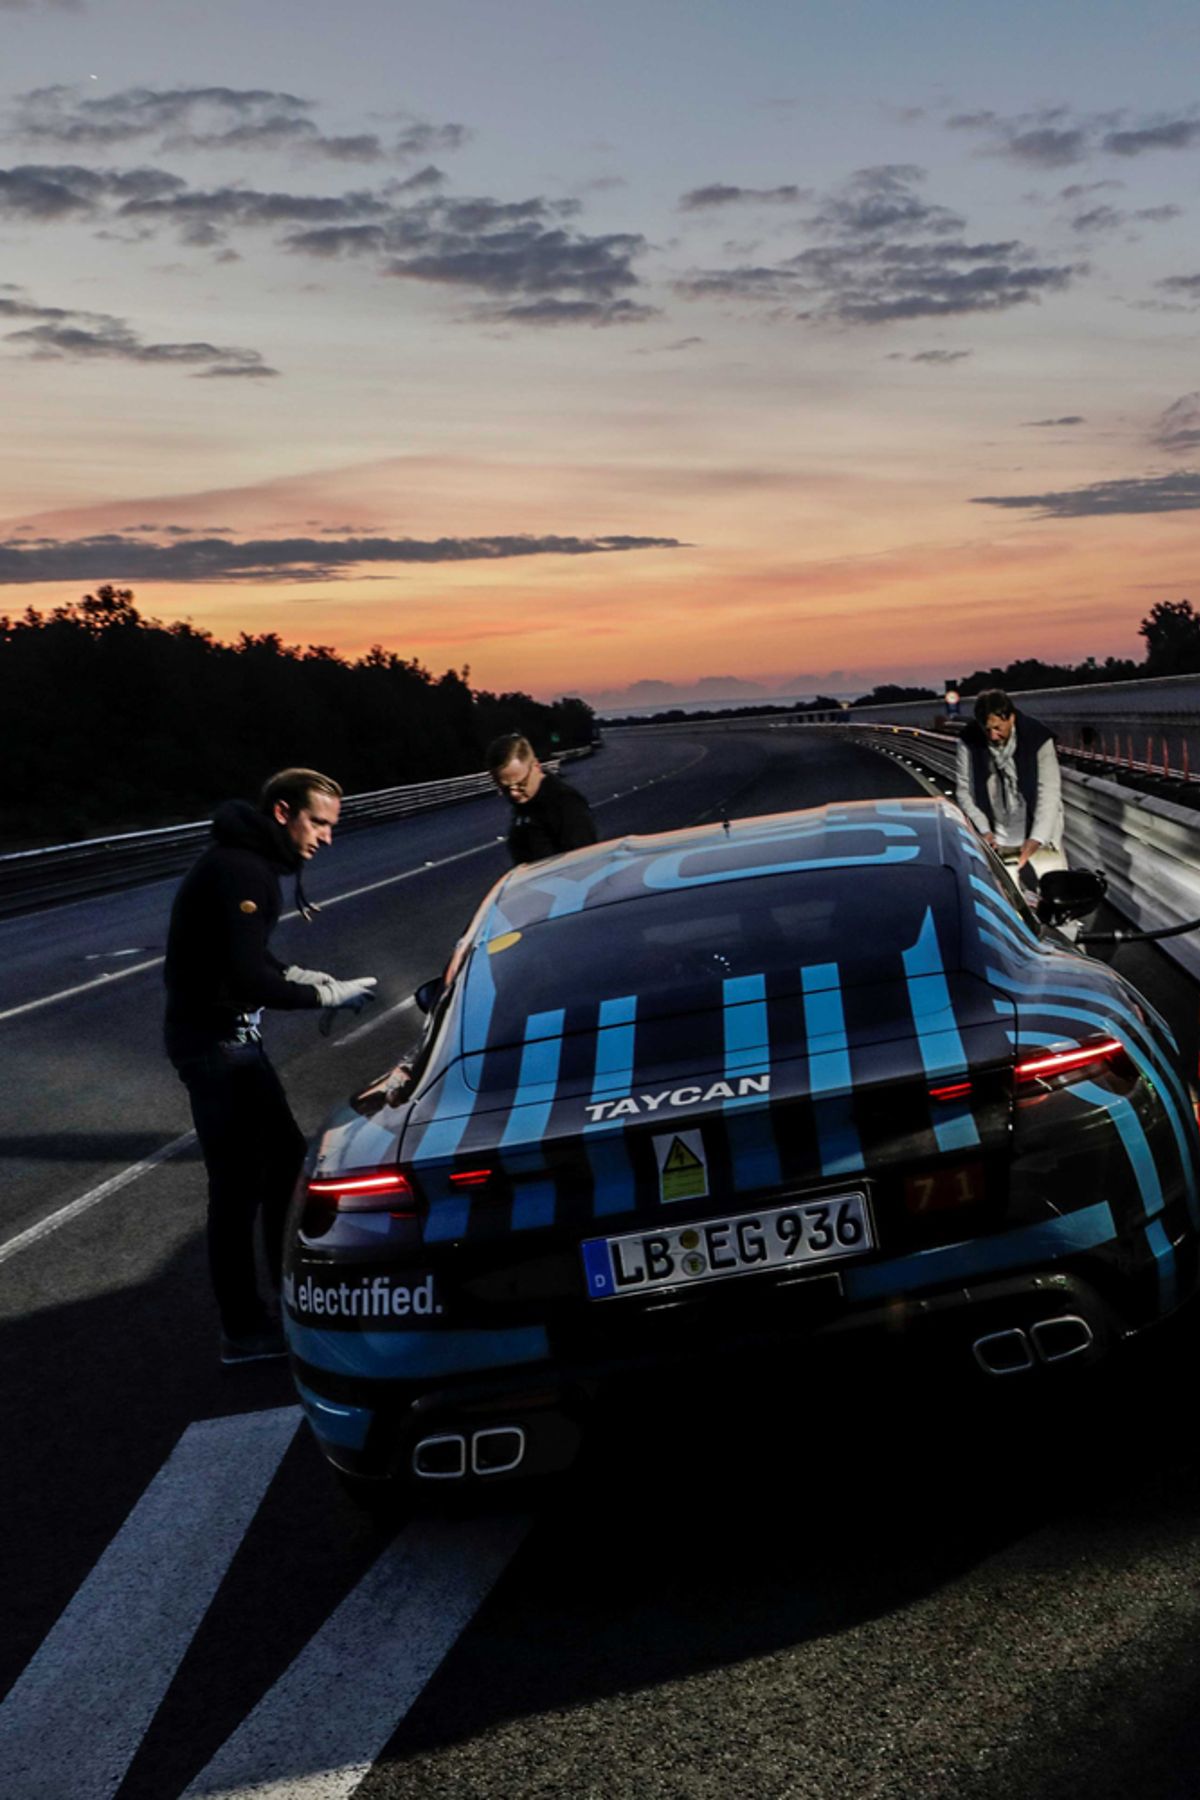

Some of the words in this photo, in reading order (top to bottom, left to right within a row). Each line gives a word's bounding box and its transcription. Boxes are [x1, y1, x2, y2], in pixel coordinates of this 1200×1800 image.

[585, 1074, 770, 1122] TAYCAN
[611, 1236, 675, 1286] LB
[704, 1220, 767, 1270] EG
[776, 1203, 861, 1257] 936
[298, 1273, 443, 1317] electrified.
